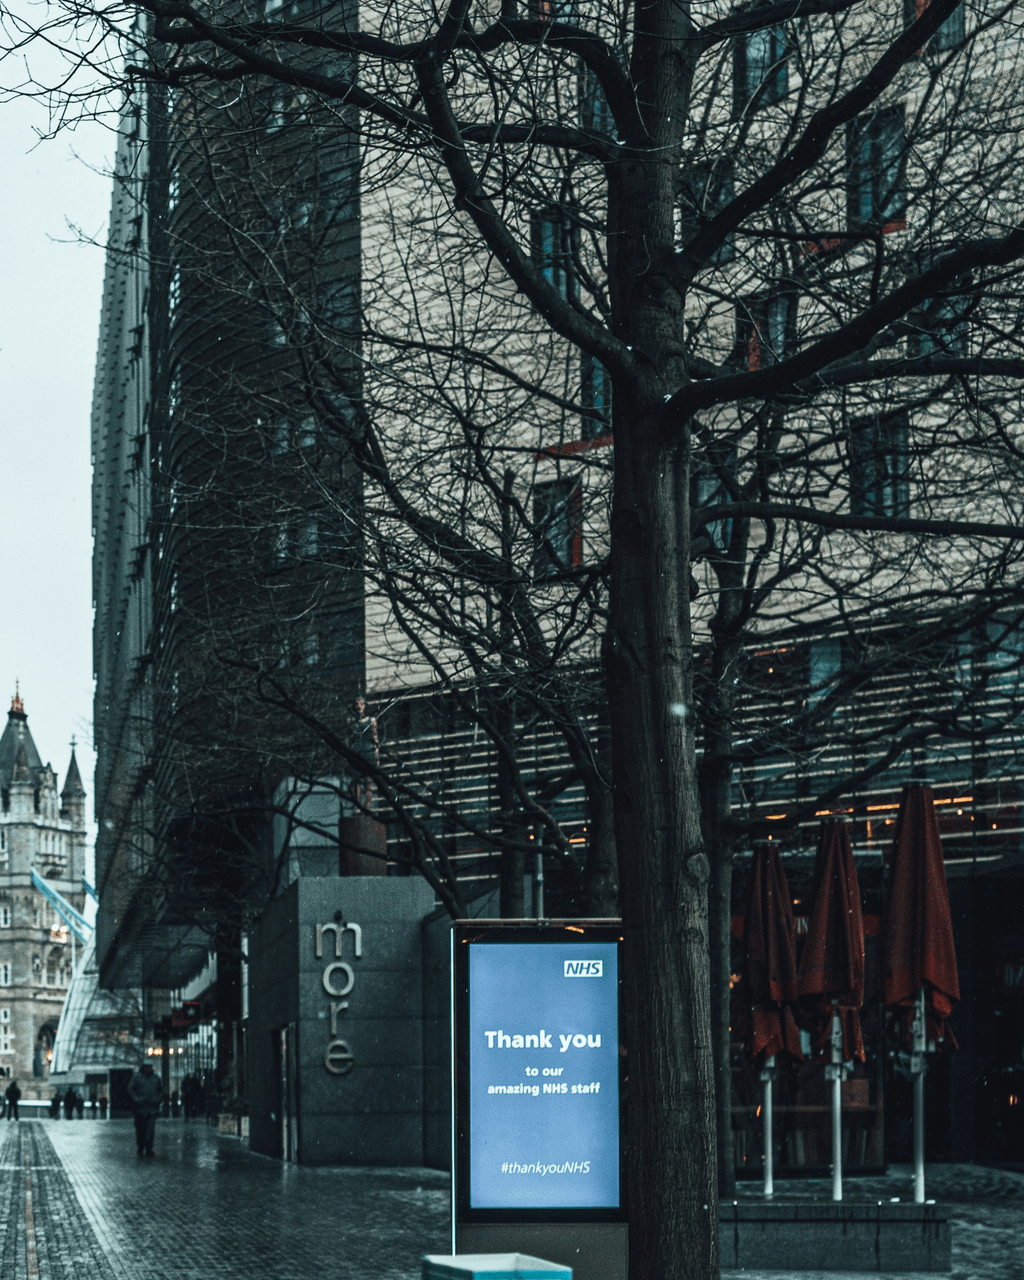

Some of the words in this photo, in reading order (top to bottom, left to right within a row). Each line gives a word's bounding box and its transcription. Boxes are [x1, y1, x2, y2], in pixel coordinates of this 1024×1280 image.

[565, 961, 601, 976] NHS
[316, 922, 362, 1074] more
[484, 1029, 553, 1048] Thank
[559, 1033, 602, 1052] you
[525, 1066, 539, 1077] to
[542, 1067, 564, 1077] our
[487, 1083, 540, 1096] amazing
[542, 1083, 568, 1094] NHS
[570, 1081, 601, 1094] staff
[500, 1161, 591, 1176] #thankyouNHS
